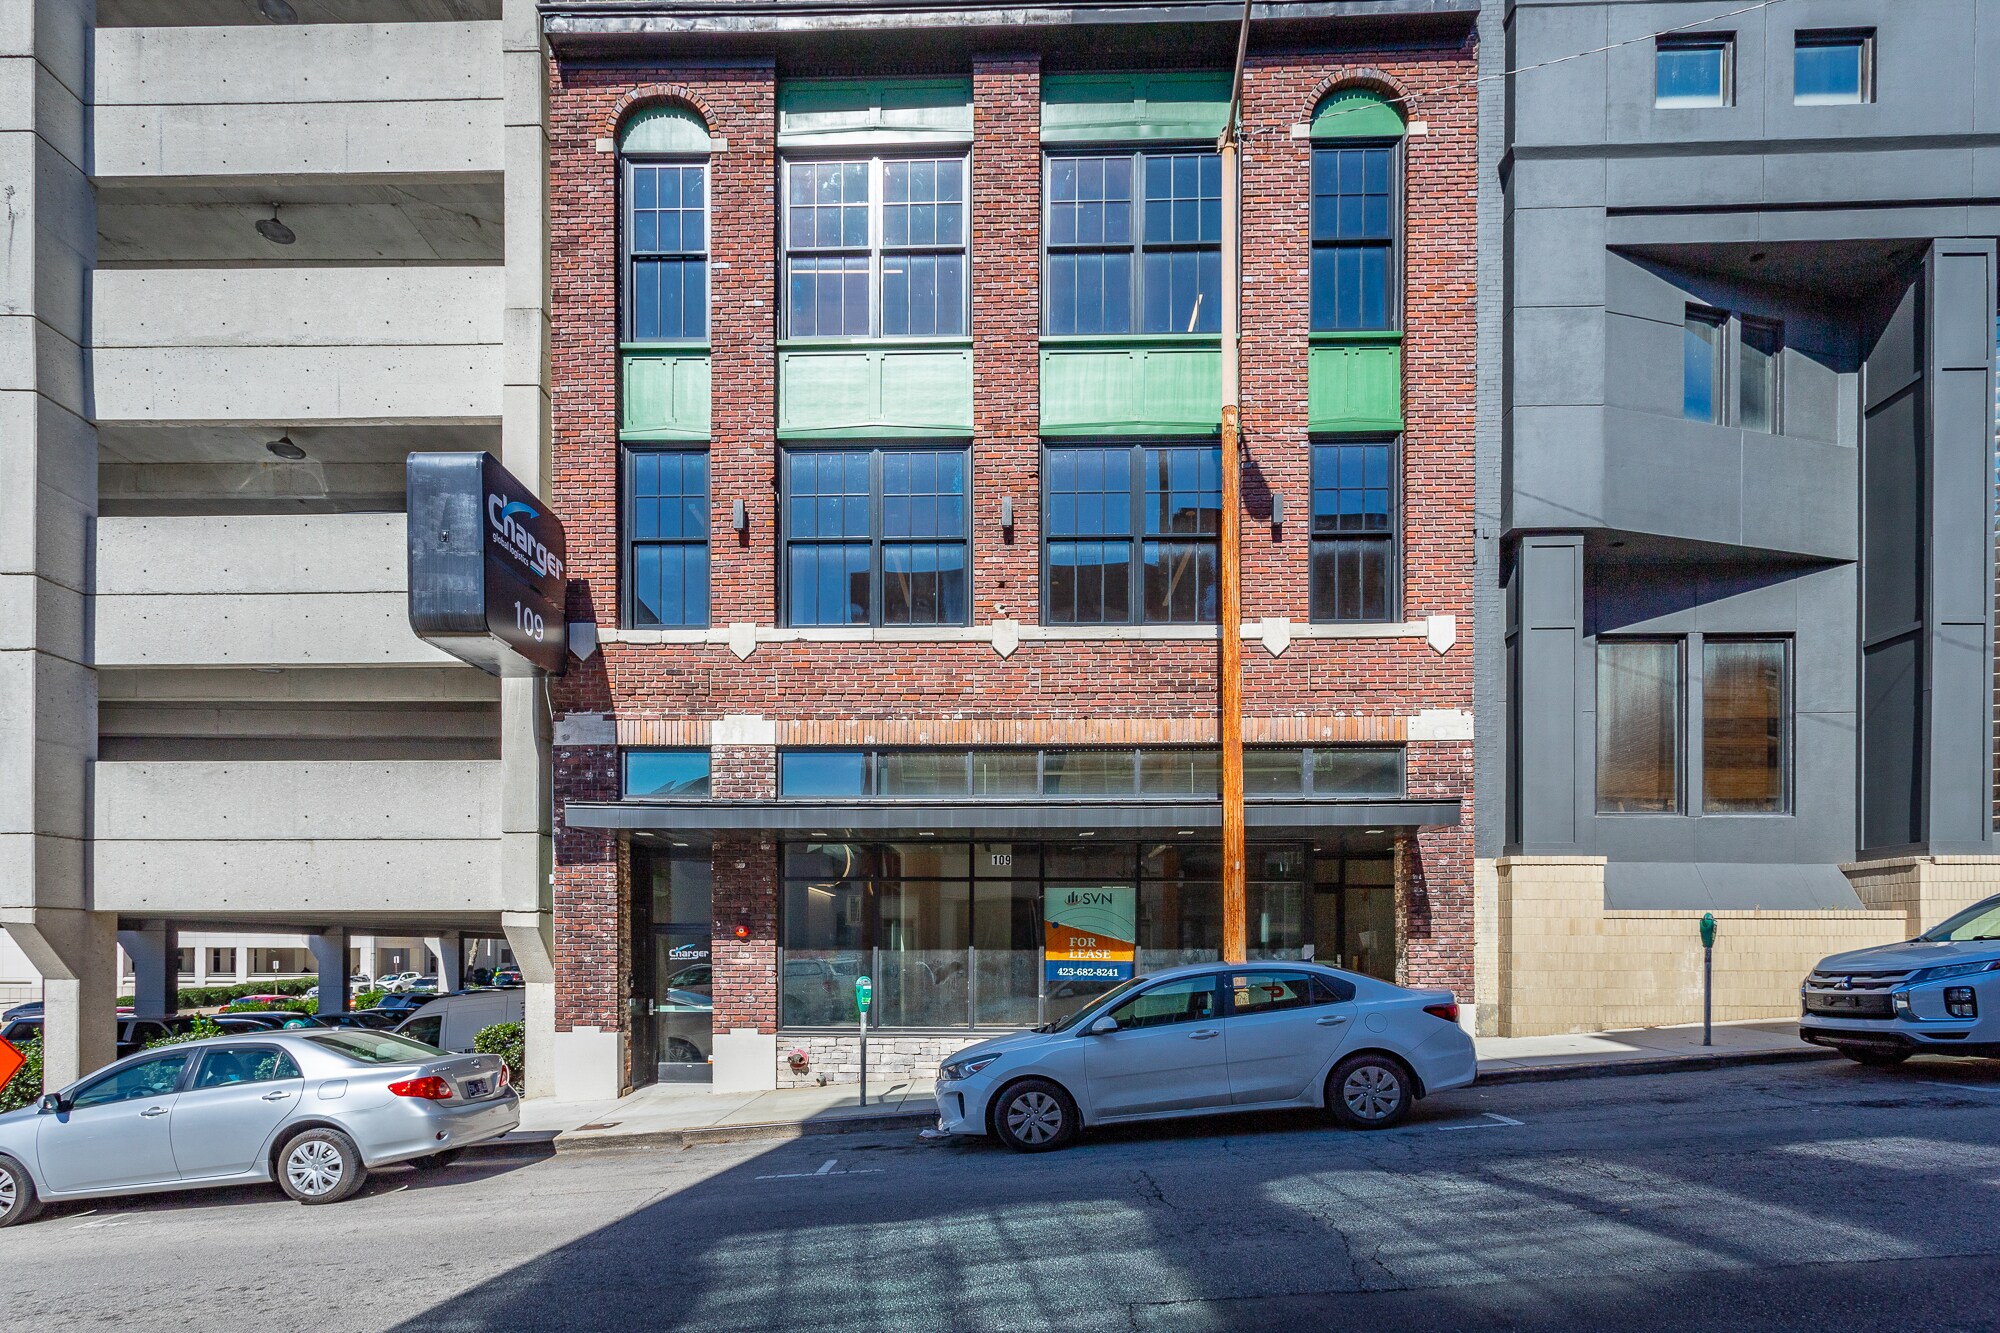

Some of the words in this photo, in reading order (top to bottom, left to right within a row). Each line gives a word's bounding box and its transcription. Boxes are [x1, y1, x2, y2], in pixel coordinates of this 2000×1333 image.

[488, 494, 562, 580] Charger
[492, 533, 510, 551] global
[509, 543, 529, 566] logistics
[514, 600, 543, 642] 109
[993, 855, 1011, 865] 109
[1083, 892, 1113, 905] SVN
[1069, 937, 1097, 948] FOR
[669, 946, 709, 960] Charger
[1069, 949, 1112, 959] LEASE
[1057, 967, 1119, 977] 423-682-8241
